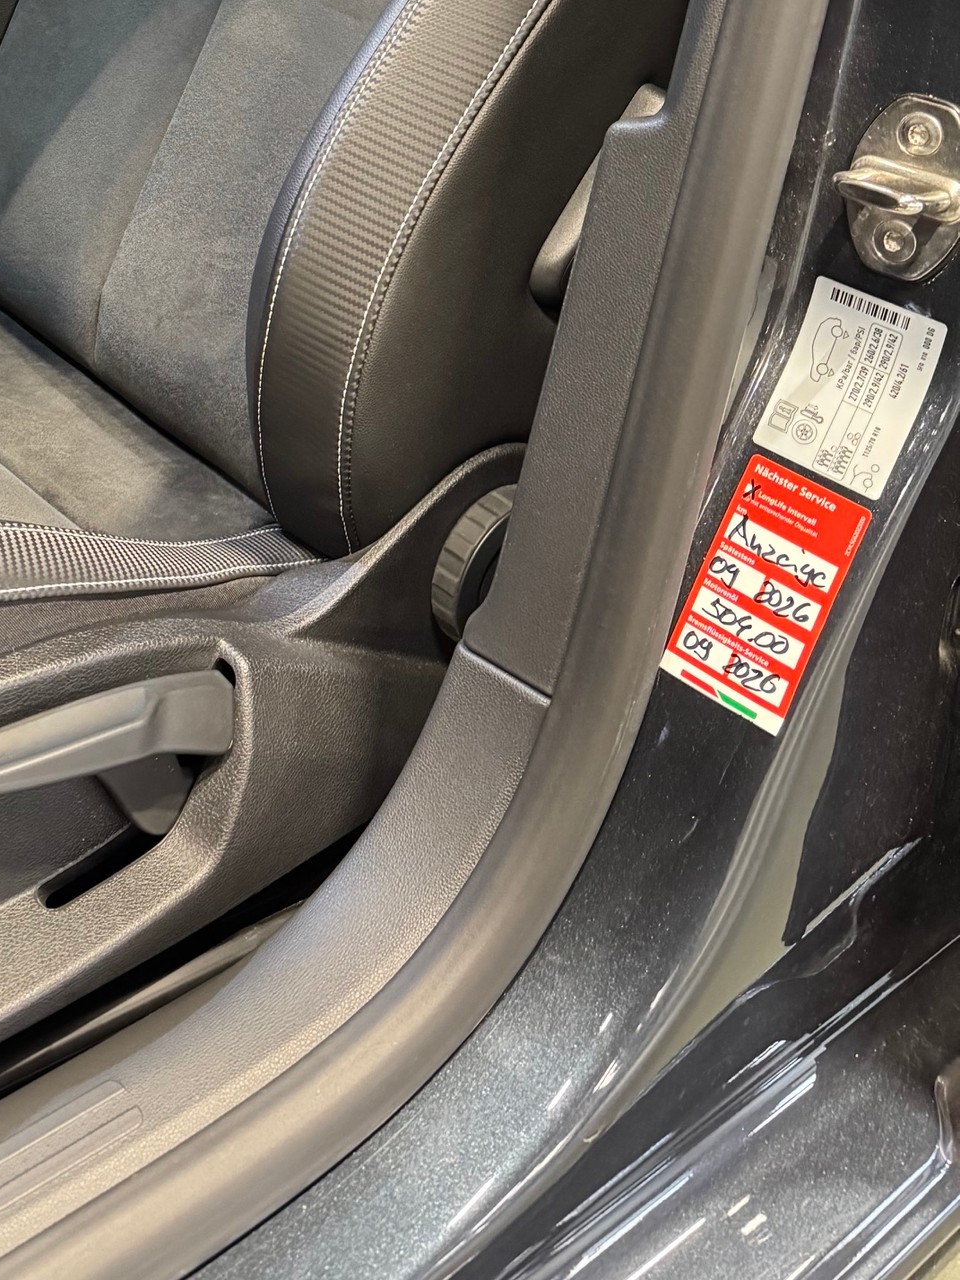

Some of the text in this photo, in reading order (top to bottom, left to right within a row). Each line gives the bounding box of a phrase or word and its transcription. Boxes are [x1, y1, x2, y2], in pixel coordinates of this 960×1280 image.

[754, 463, 837, 512] Nächster Service
[736, 504, 748, 516] km
[758, 491, 818, 527] LongLife Intervall
[719, 541, 756, 566] Spätestens
[709, 555, 740, 589] 09
[703, 577, 739, 603] Motorenöl
[687, 614, 770, 667] Bremsflüssigkeits-Service
[683, 630, 781, 694] 09 2026
